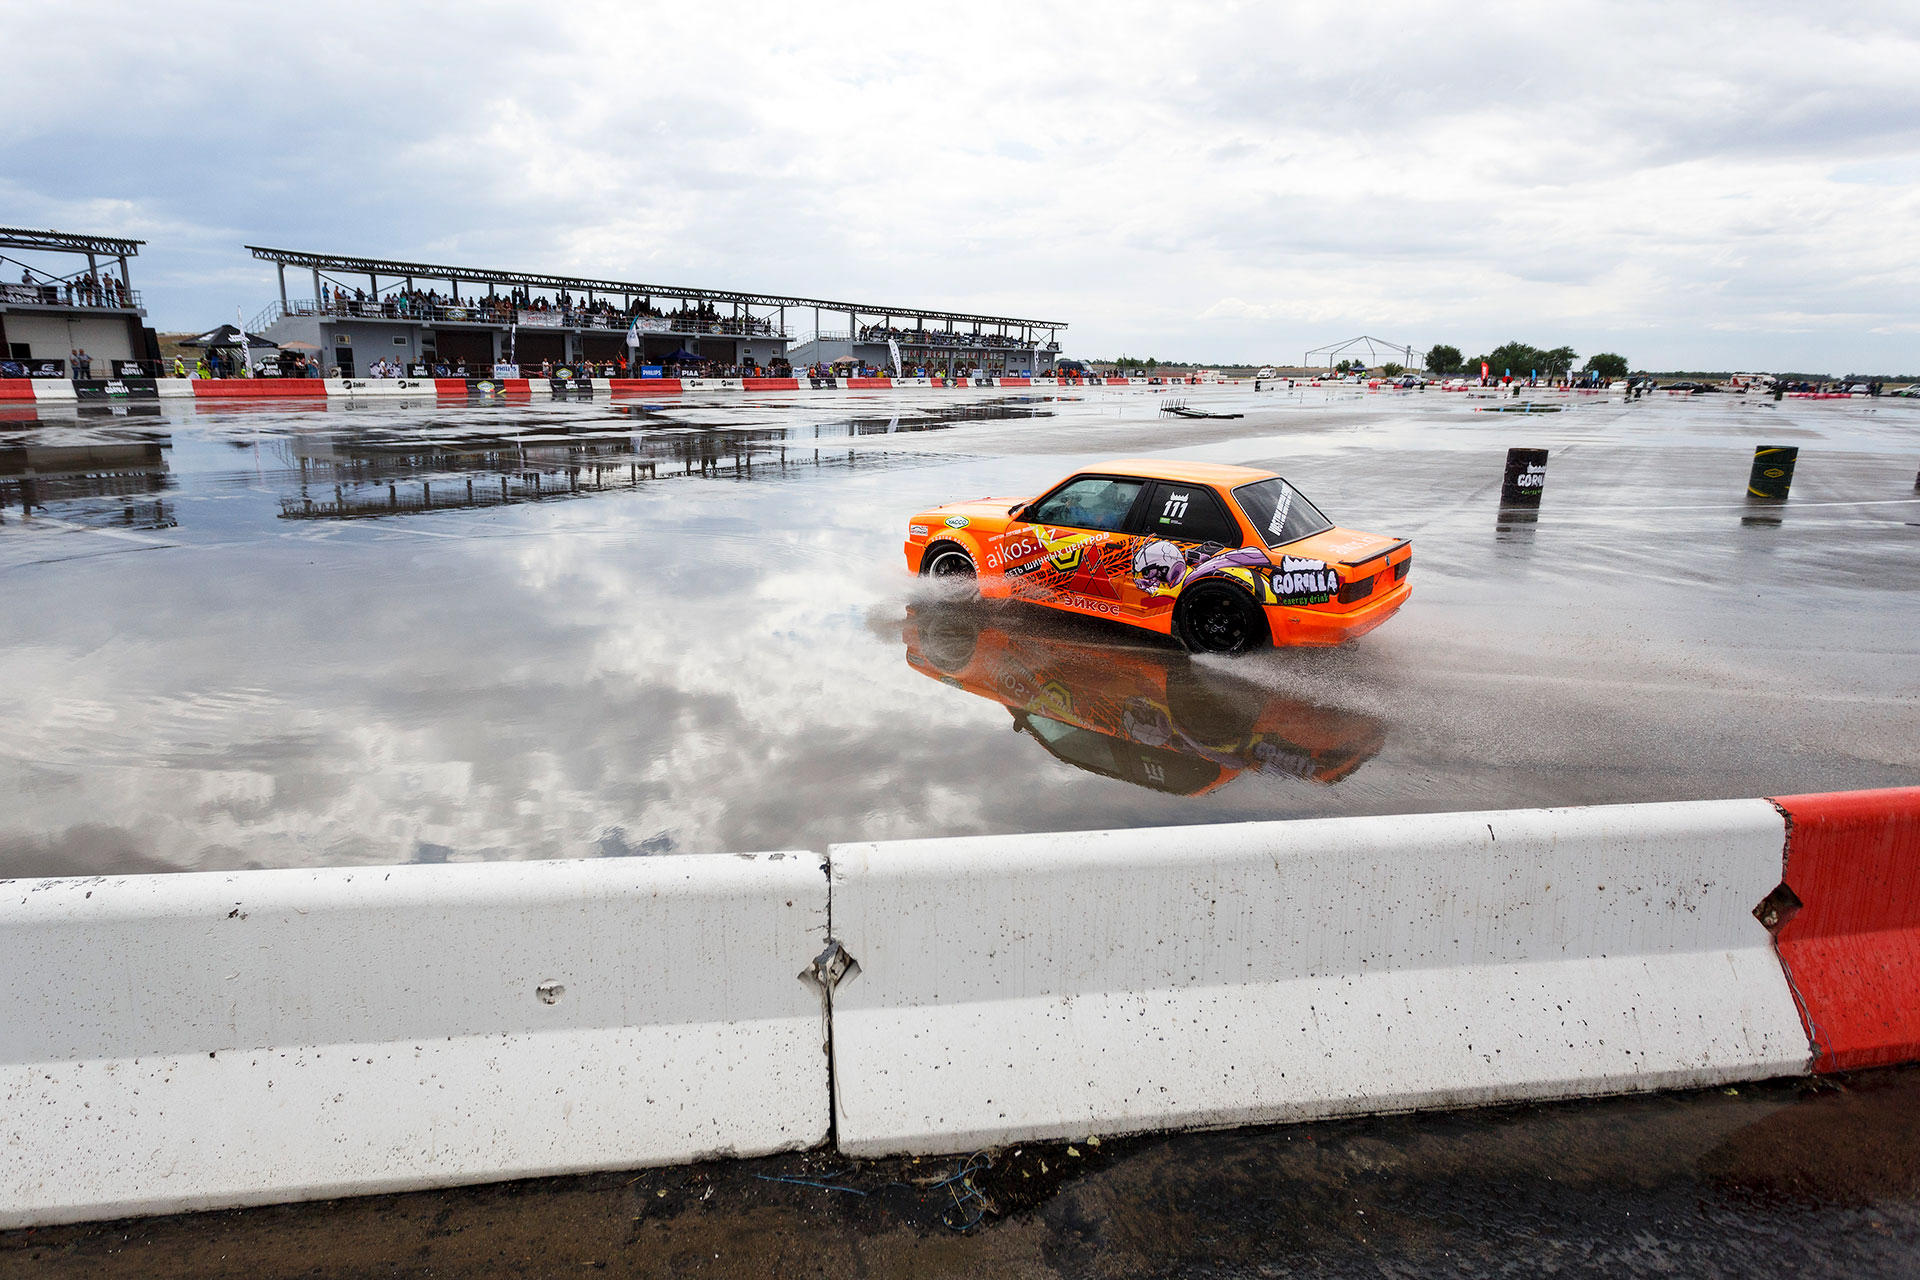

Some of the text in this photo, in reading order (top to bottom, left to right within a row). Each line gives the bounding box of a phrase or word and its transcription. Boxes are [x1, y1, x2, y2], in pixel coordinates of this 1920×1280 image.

[1162, 500, 1189, 519] 111
[986, 525, 1058, 569] aikos.kz
[1024, 549, 1064, 571] ШИННЫХ
[1064, 531, 1110, 555] ЦЕНТРОВ
[1272, 570, 1338, 594] GORILLA
[1064, 595, 1120, 616] ЭЙКОС
[1283, 592, 1330, 606] energy drink
